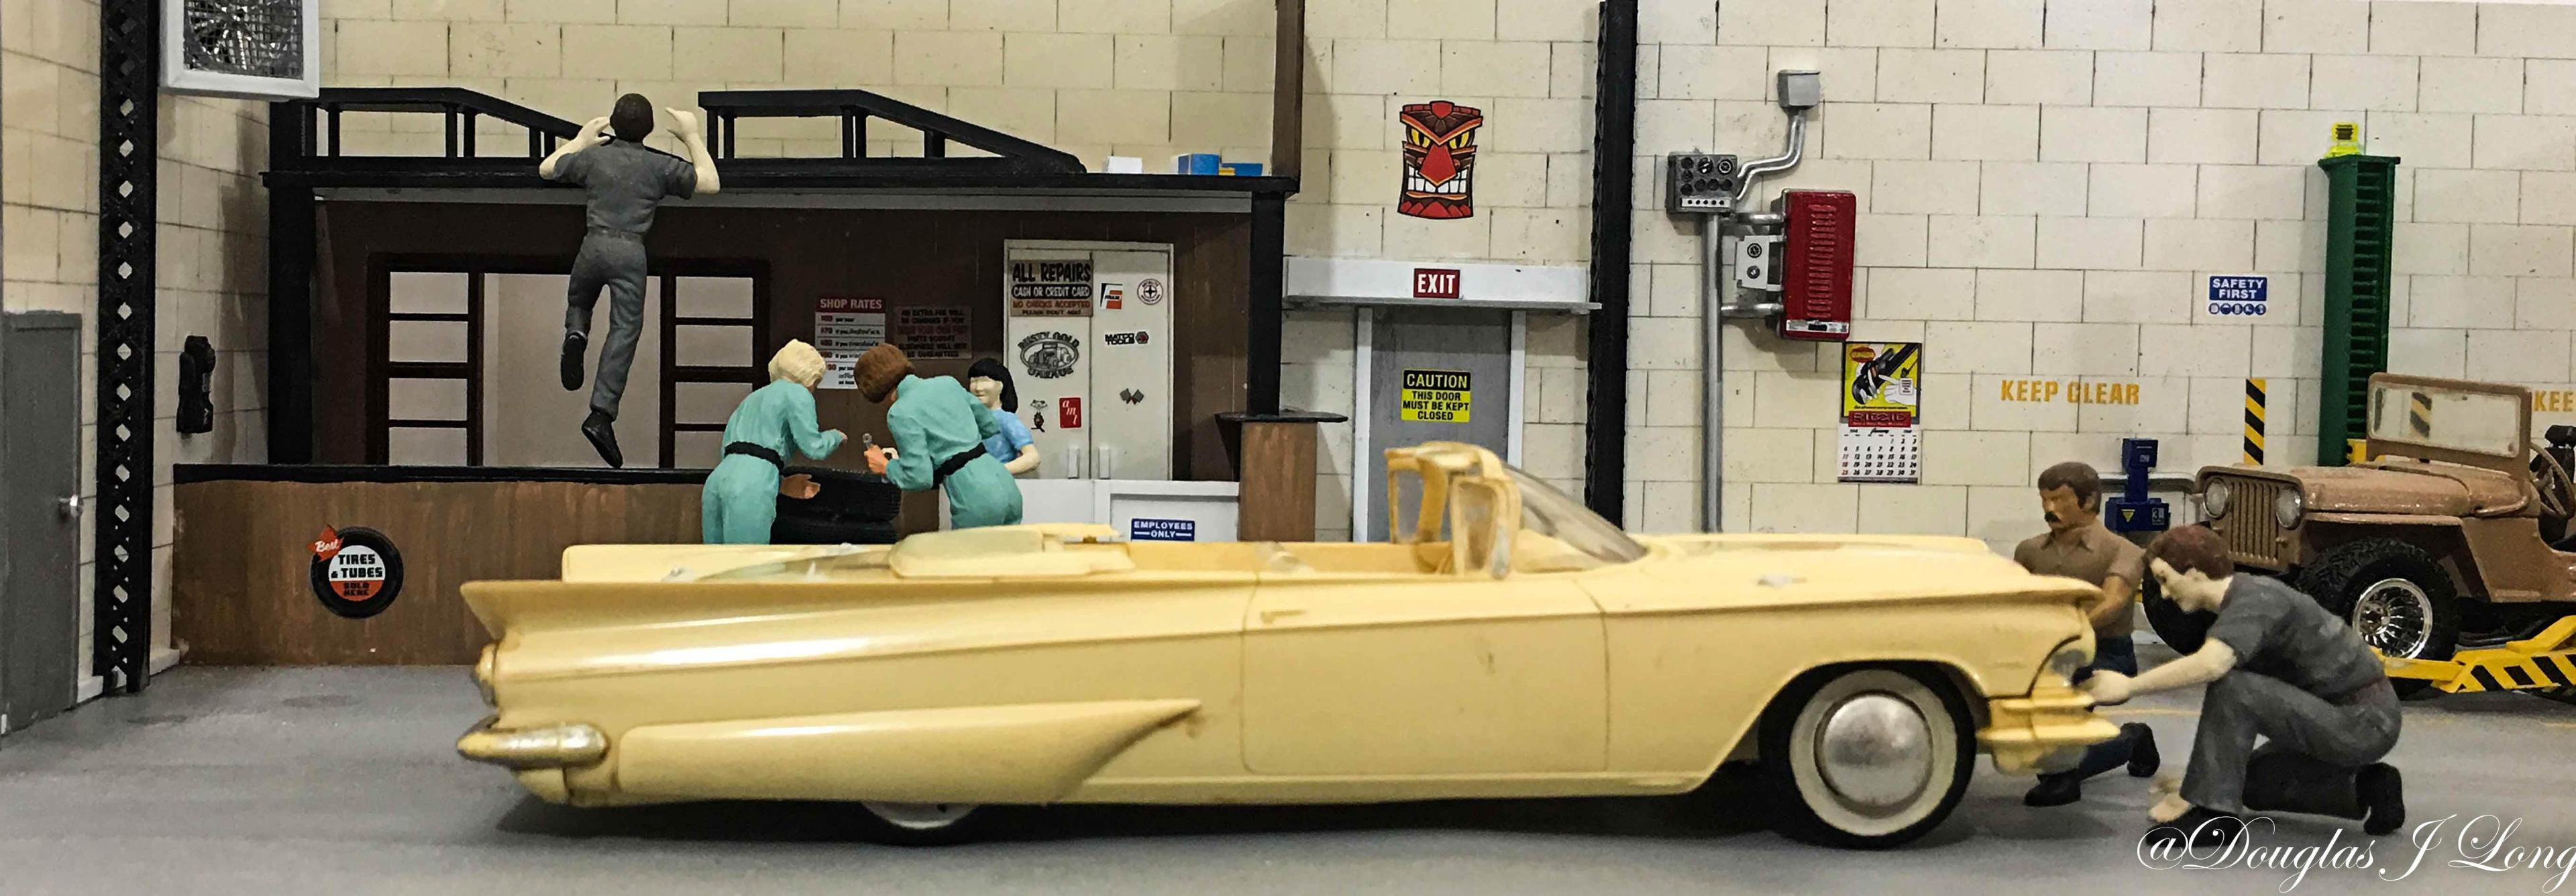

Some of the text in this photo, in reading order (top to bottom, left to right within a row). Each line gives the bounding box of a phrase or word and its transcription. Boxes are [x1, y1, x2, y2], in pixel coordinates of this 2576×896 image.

[1012, 262, 1091, 283] ALL REPAIRS
[1417, 274, 1456, 294] EXIT
[2212, 278, 2264, 289] SAFETY
[1014, 287, 1090, 297] CASH OR CREDIT CARD
[2219, 289, 2257, 299] FIRST
[820, 299, 882, 309] SHOP RATES
[1407, 373, 1467, 389] CAUTION
[1412, 391, 1460, 401] THIS DOOR
[2000, 379, 2140, 405] KEEP CLEAR
[1403, 400, 1469, 411] MUST BE KEPT
[1417, 411, 1453, 420] CLOSED
[1134, 521, 1193, 530] EMPLOYEES
[1150, 530, 1175, 538] ONLY
[315, 539, 339, 552] Best
[339, 554, 376, 564] TIRES
[341, 568, 382, 578] TUBES
